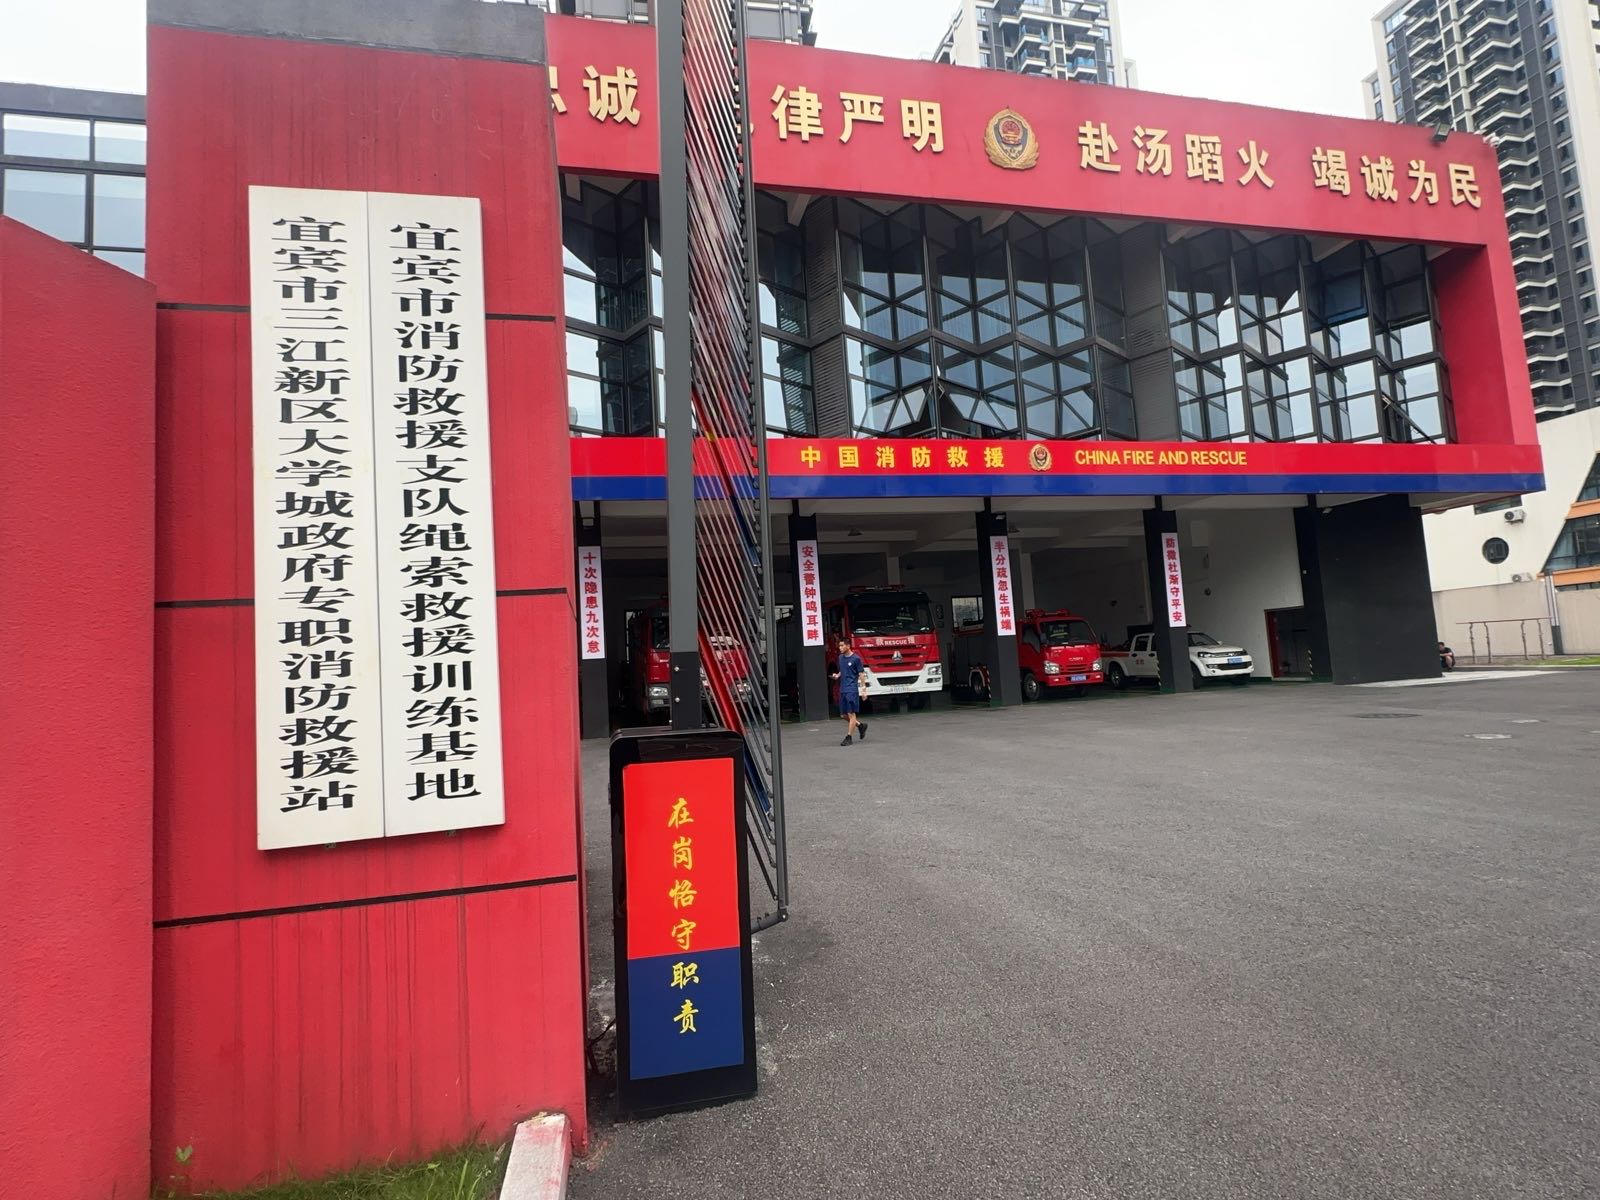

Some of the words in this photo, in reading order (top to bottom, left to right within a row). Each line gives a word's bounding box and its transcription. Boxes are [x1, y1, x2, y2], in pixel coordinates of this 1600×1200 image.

[750, 85, 944, 153] 律严明
[1077, 120, 1275, 188] 赴汤蹈火
[1312, 146, 1482, 208] 竭诚为民
[389, 222, 482, 801] 宜宾市消防救援支队绳索救援训练基地
[800, 446, 1005, 468] 中国消防救援
[1075, 450, 1121, 465] CHINA
[1123, 450, 1155, 465] FIRE
[1158, 450, 1189, 465] AND
[1191, 450, 1248, 466] RESCUE
[272, 216, 359, 812] 宜宾市三江新区大学城政府专职消防救援站
[583, 551, 600, 653] 十次隐患九次怠
[801, 545, 819, 641] 安全警钟鸣耳畔
[667, 797, 700, 1034] 在岗恪守职责
